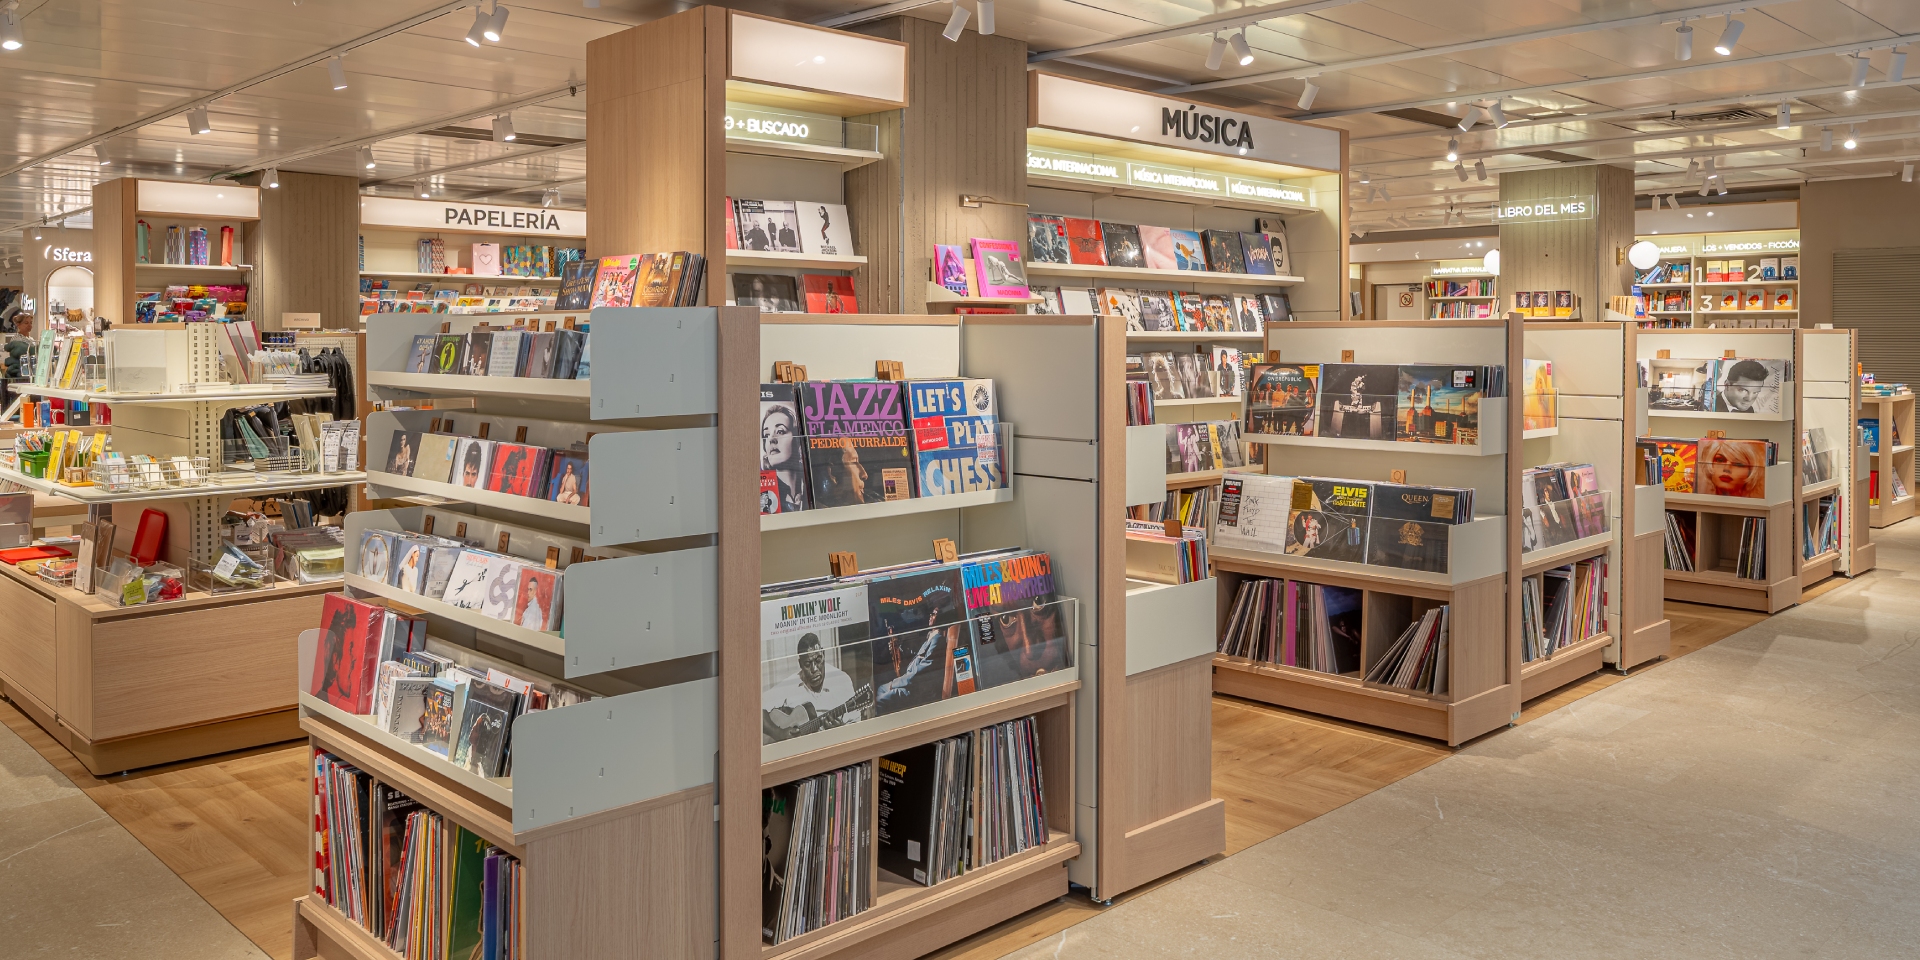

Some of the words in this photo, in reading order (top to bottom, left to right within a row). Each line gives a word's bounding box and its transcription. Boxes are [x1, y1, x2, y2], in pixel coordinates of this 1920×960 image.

[725, 116, 734, 130] O
[747, 118, 809, 138] BUSCADO
[1161, 104, 1254, 150] MÚSICA
[1027, 152, 1052, 170] ÚSICA
[1052, 159, 1119, 178] INTERNACIONAL
[1134, 168, 1163, 184] MÚSICA
[1163, 174, 1220, 191] INTERNACIONAL
[1231, 181, 1256, 196] MÚSICA
[1256, 186, 1306, 202] INTERNACIONAL
[1498, 205, 1532, 218] LIBRO
[1535, 204, 1558, 216] DEL
[1560, 202, 1585, 213] MES
[444, 207, 561, 231] PAPELERÍA
[53, 247, 93, 262] Sfera
[1658, 245, 1687, 253] ANJERA
[1702, 243, 1717, 253] LOS
[1724, 242, 1763, 251] VENDIDOS
[1768, 239, 1800, 249] FICCIÓN
[1695, 266, 1703, 282] 1
[1747, 265, 1762, 283] 2
[1700, 295, 1713, 312] 3
[1270, 350, 1279, 361] O
[1344, 351, 1351, 362] P
[794, 366, 805, 381] D
[892, 362, 901, 377] H
[804, 383, 903, 421] JAZZ
[916, 383, 962, 413] LET'S
[806, 420, 906, 438] FLAMENCO
[951, 420, 995, 445] PLAY
[809, 437, 847, 449] PEDRO
[848, 436, 908, 449] ITURRALDE
[925, 457, 1002, 496] CHESS
[1393, 470, 1402, 483] Q
[1333, 485, 1368, 498] ELVIS
[1401, 493, 1429, 504] QUEEN
[1240, 524, 1257, 538] WALL
[944, 543, 955, 561] S
[841, 556, 855, 573] M
[962, 561, 1003, 589] MILES
[1000, 560, 1012, 583] &
[1007, 552, 1051, 584] QUINCY
[965, 585, 991, 609] LIVE
[989, 583, 1002, 605] AT
[1001, 574, 1056, 602] MONTREUX
[781, 600, 818, 621] HOWLIN'
[818, 597, 841, 614] WOLF
[880, 597, 902, 605] MILES
[903, 595, 923, 606] DAVIS
[774, 619, 799, 629] MOANIN'
[818, 610, 849, 621] MOONLIGHT
